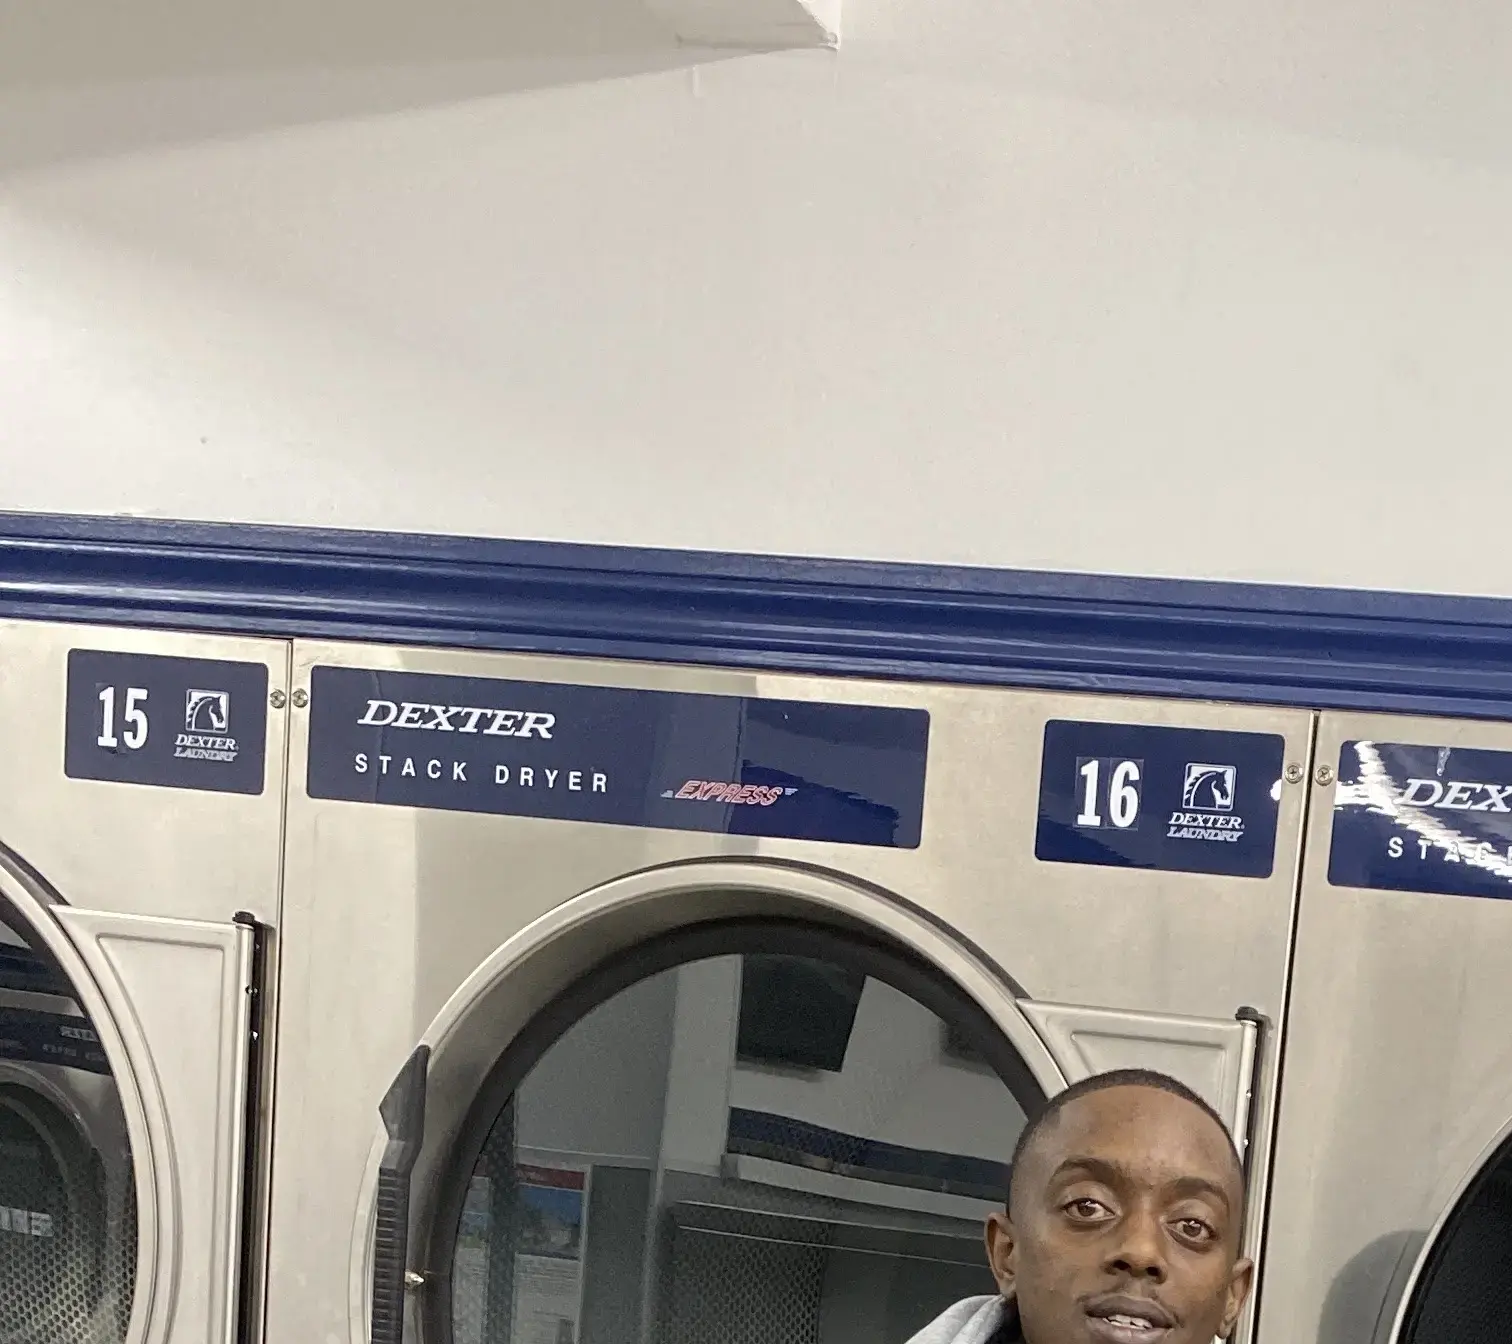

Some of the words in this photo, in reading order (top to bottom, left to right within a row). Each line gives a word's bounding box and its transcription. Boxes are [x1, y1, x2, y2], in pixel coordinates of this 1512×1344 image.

[97, 686, 149, 748] 15
[357, 700, 555, 739] DEXTER
[174, 746, 237, 762] LAUNDRY
[175, 733, 237, 751] DEXTER
[355, 753, 466, 782] STACK
[495, 764, 608, 793] DRYER
[675, 780, 784, 806] EXPRESS
[1076, 759, 1139, 828] 16
[1169, 811, 1244, 829] DEXTER
[1166, 826, 1242, 843] LAUNDRY
